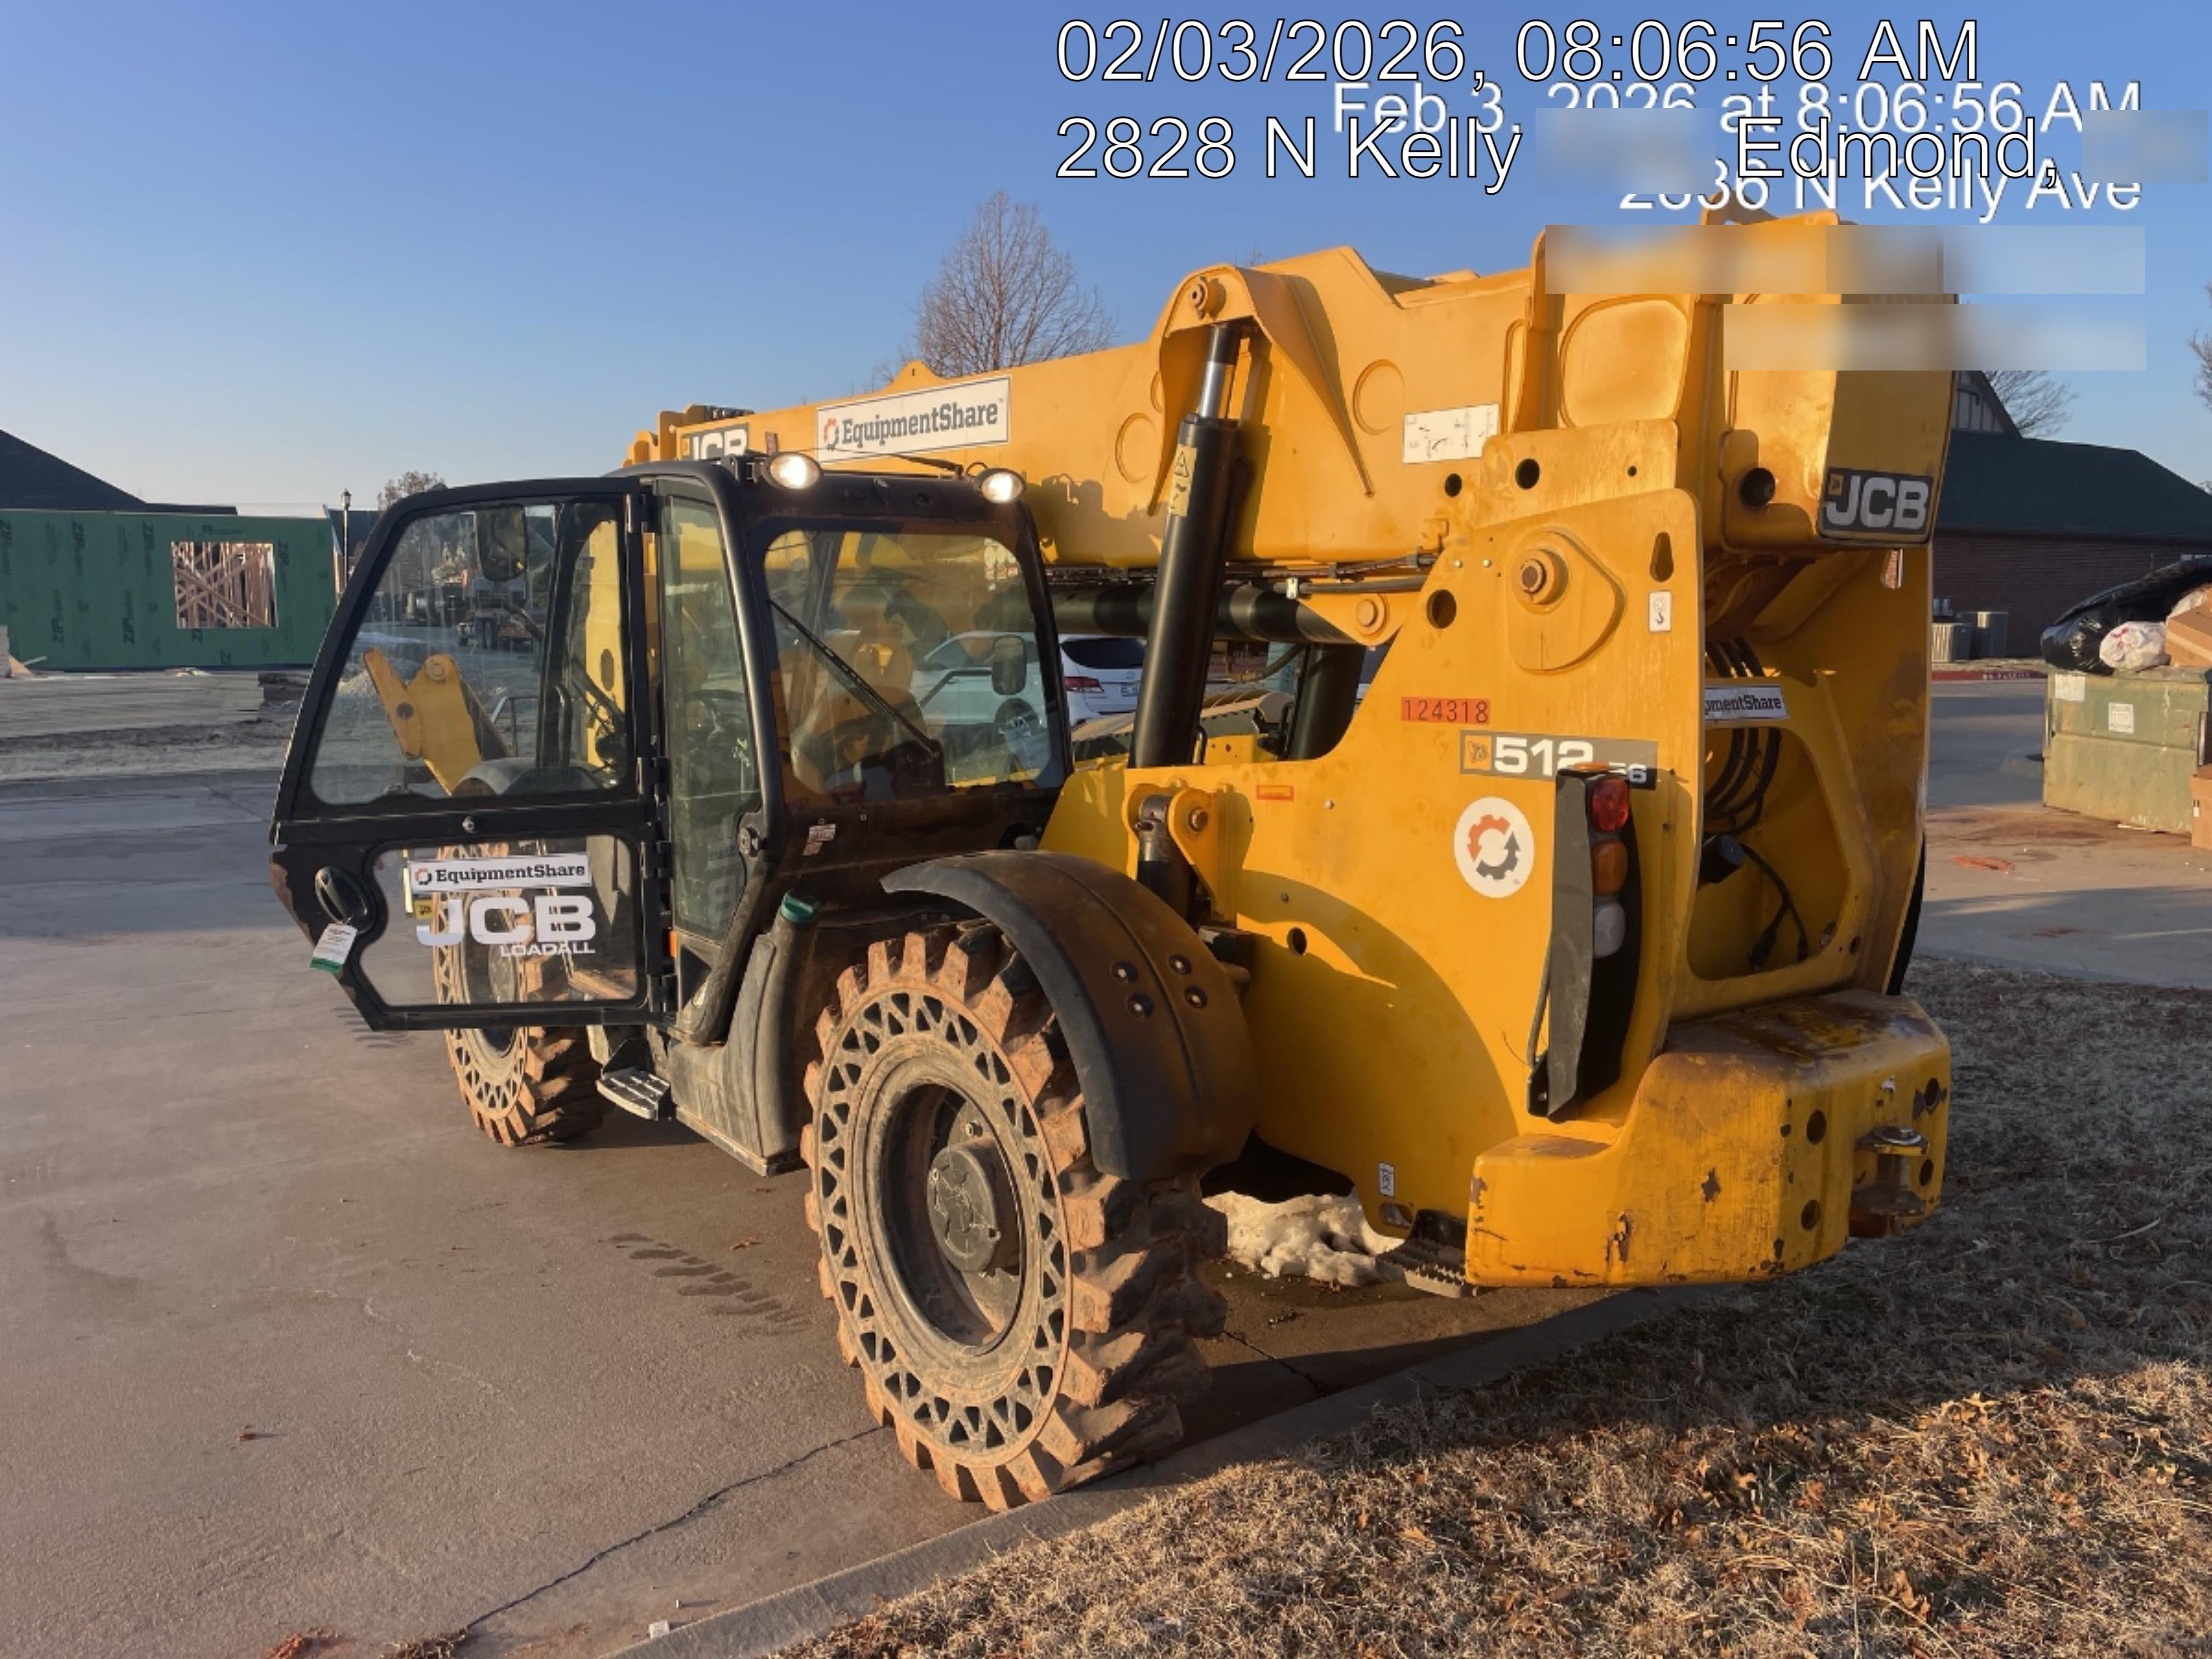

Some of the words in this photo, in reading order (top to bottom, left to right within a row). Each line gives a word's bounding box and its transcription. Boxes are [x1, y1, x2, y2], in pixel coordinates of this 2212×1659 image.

[842, 401, 998, 449] EquipmentShare
[1826, 475, 1929, 529] JCB
[1404, 699, 1488, 724] 124318
[1494, 737, 1593, 776] 512
[436, 865, 585, 884] EquipmentShare
[416, 895, 596, 946] JCB
[500, 941, 596, 957] LOADALL
